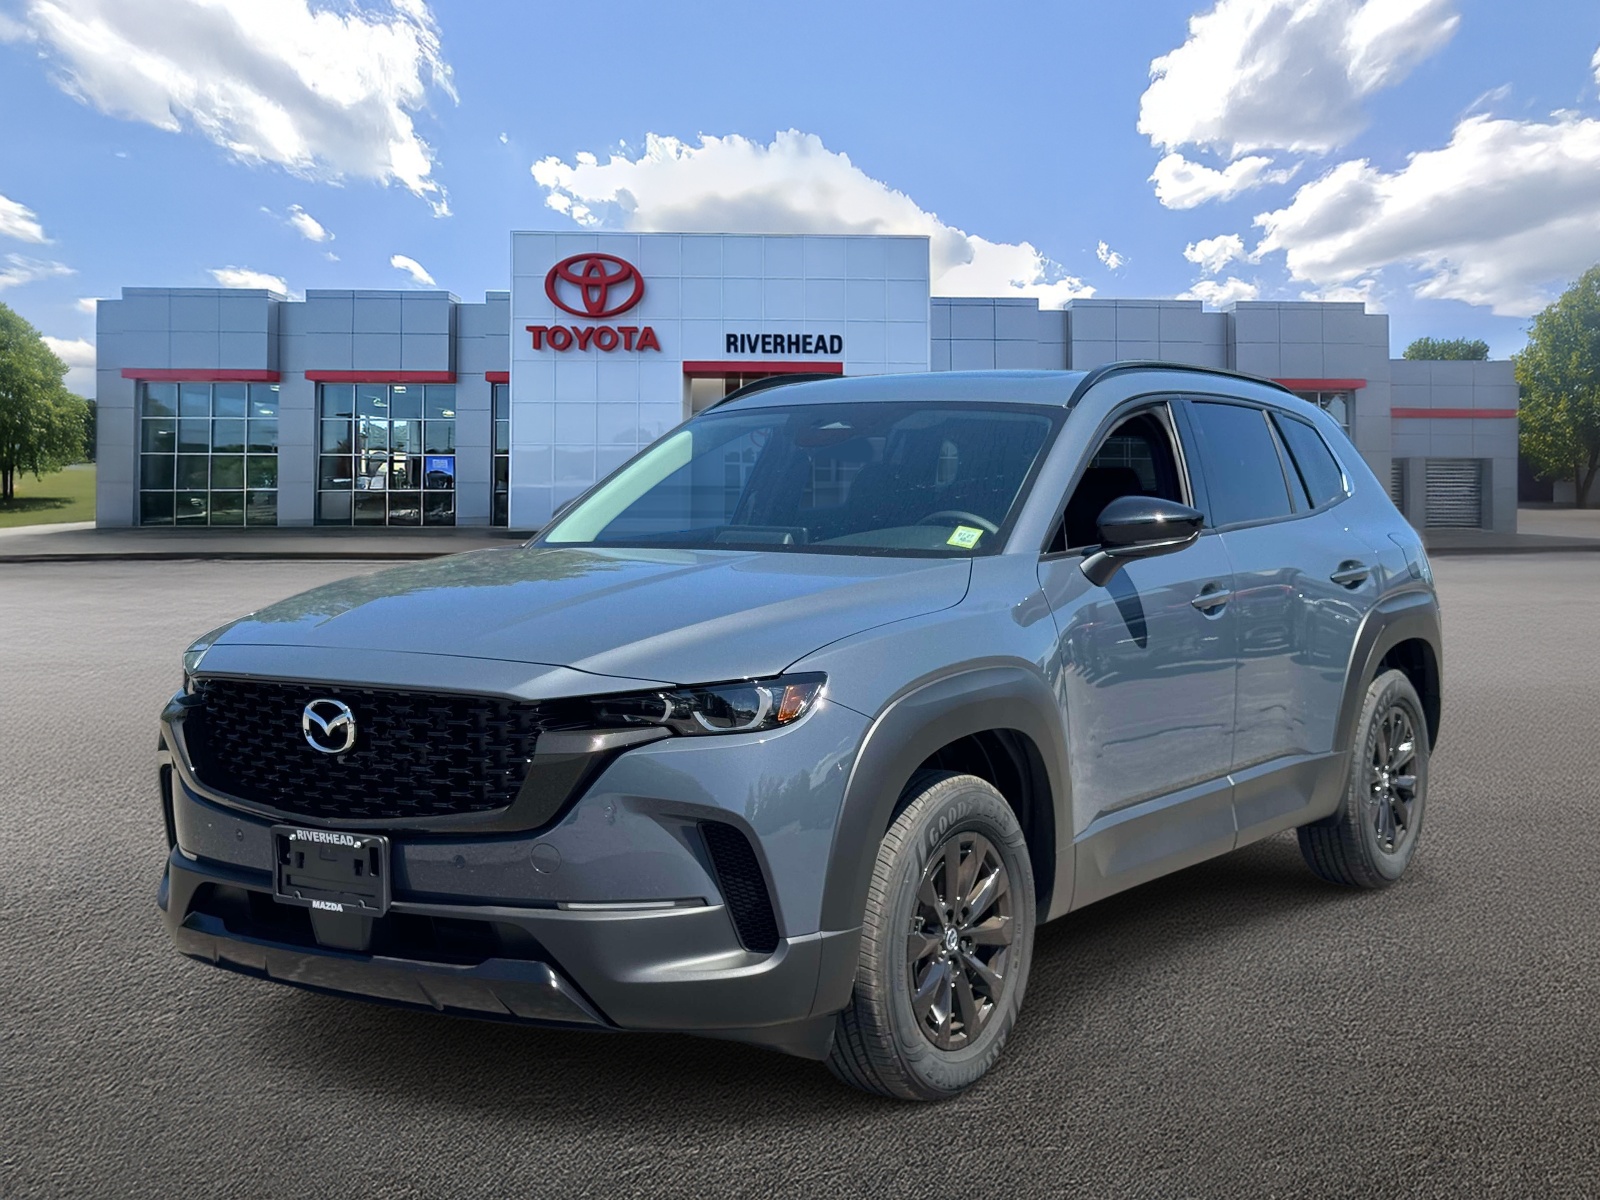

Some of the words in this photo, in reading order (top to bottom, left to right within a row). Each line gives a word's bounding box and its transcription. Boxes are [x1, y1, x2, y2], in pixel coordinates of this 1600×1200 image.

[526, 325, 661, 351] TOYOTA
[726, 333, 843, 354] RIVERHEAD
[296, 829, 355, 847] RIVERHEAD
[312, 900, 343, 912] MAZDA
